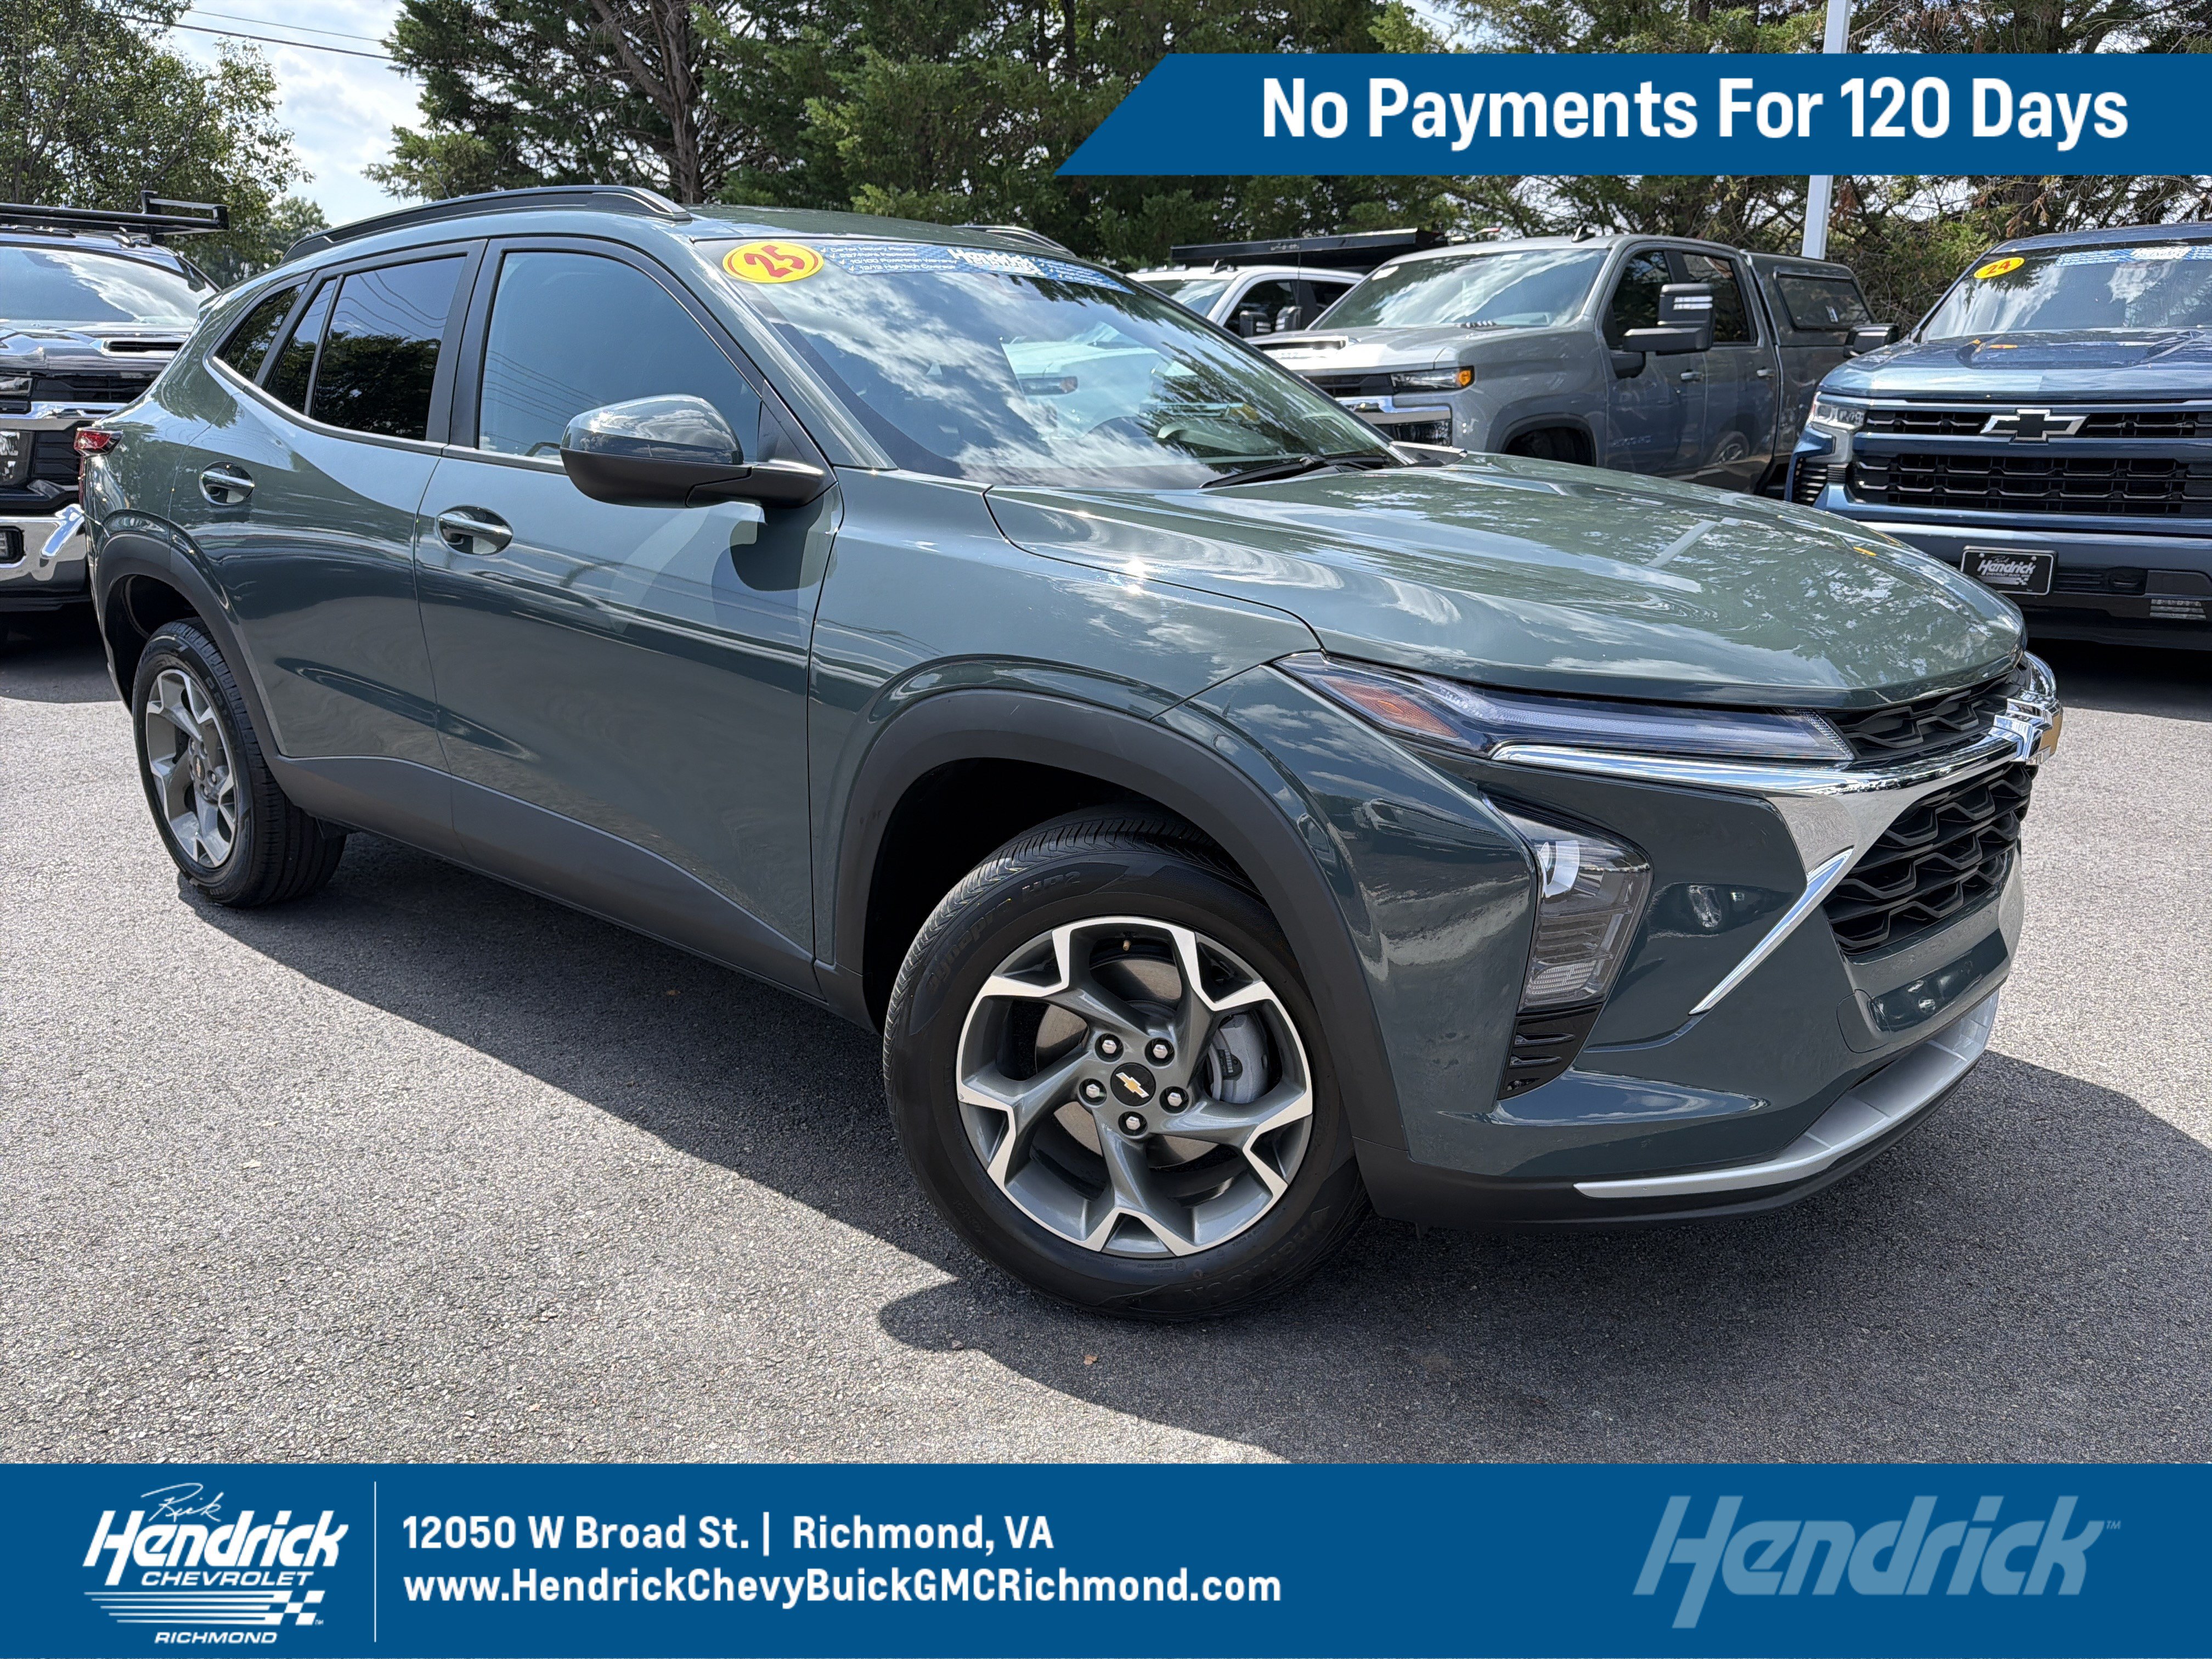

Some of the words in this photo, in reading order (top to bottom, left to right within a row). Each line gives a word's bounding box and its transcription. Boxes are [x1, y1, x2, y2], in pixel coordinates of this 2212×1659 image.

[744, 245, 805, 278] 25
[1985, 261, 2011, 275] 24
[1977, 559, 2037, 575] Hendrick
